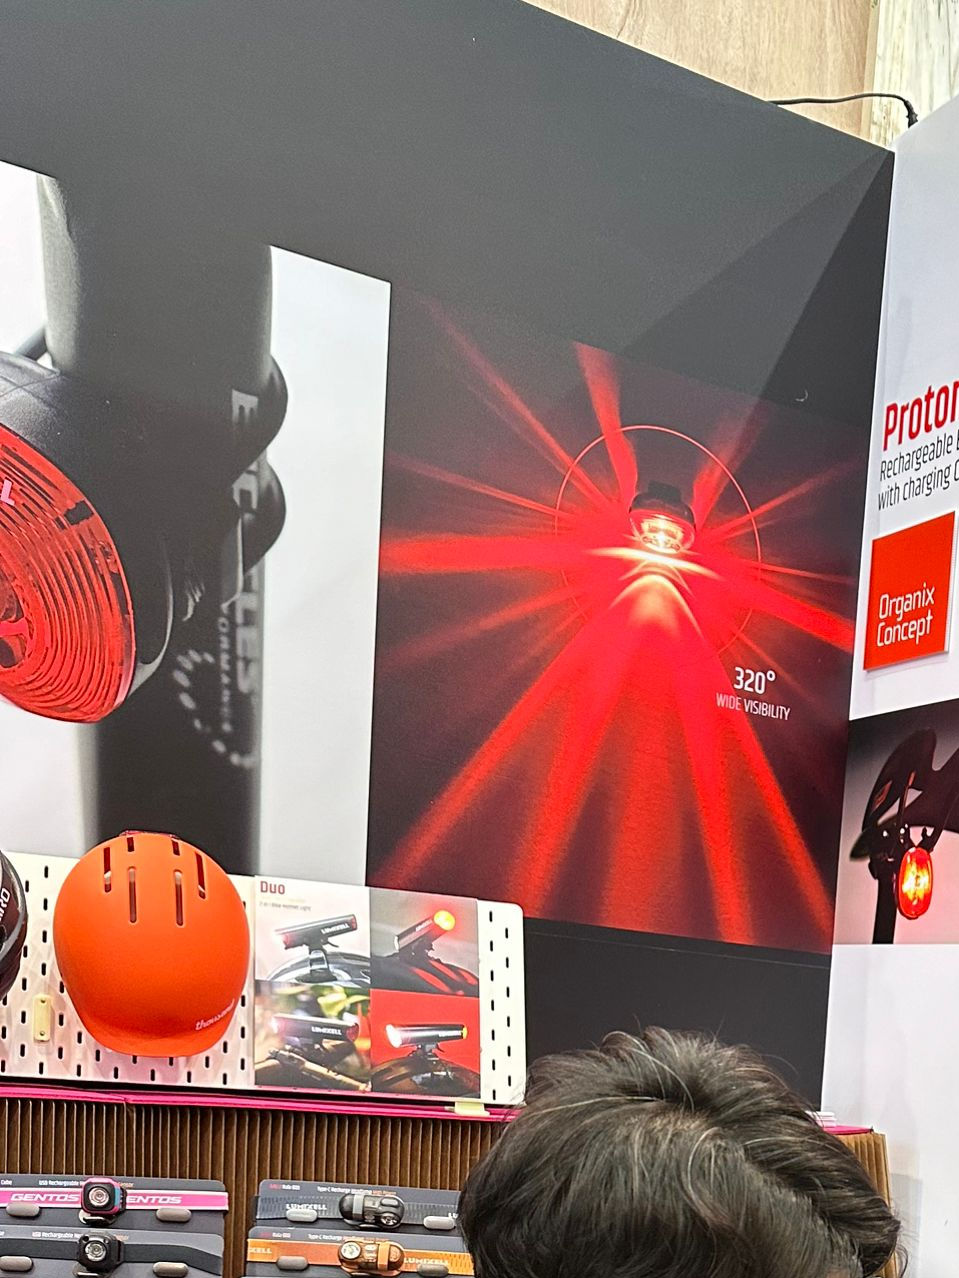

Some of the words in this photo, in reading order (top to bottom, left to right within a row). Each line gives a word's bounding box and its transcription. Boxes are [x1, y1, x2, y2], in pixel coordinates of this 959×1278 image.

[880, 433, 953, 482] Rechargeable
[878, 484, 900, 511] with
[902, 465, 951, 501] charging
[879, 582, 935, 624] Organix
[877, 609, 934, 647] Concept
[733, 667, 776, 695] 320°
[716, 692, 741, 711] WIDE
[744, 698, 791, 721] VISIBILITY
[260, 881, 285, 895] Duo
[10, 1193, 80, 1202] GENTOS
[126, 1195, 181, 1204] ENTOS
